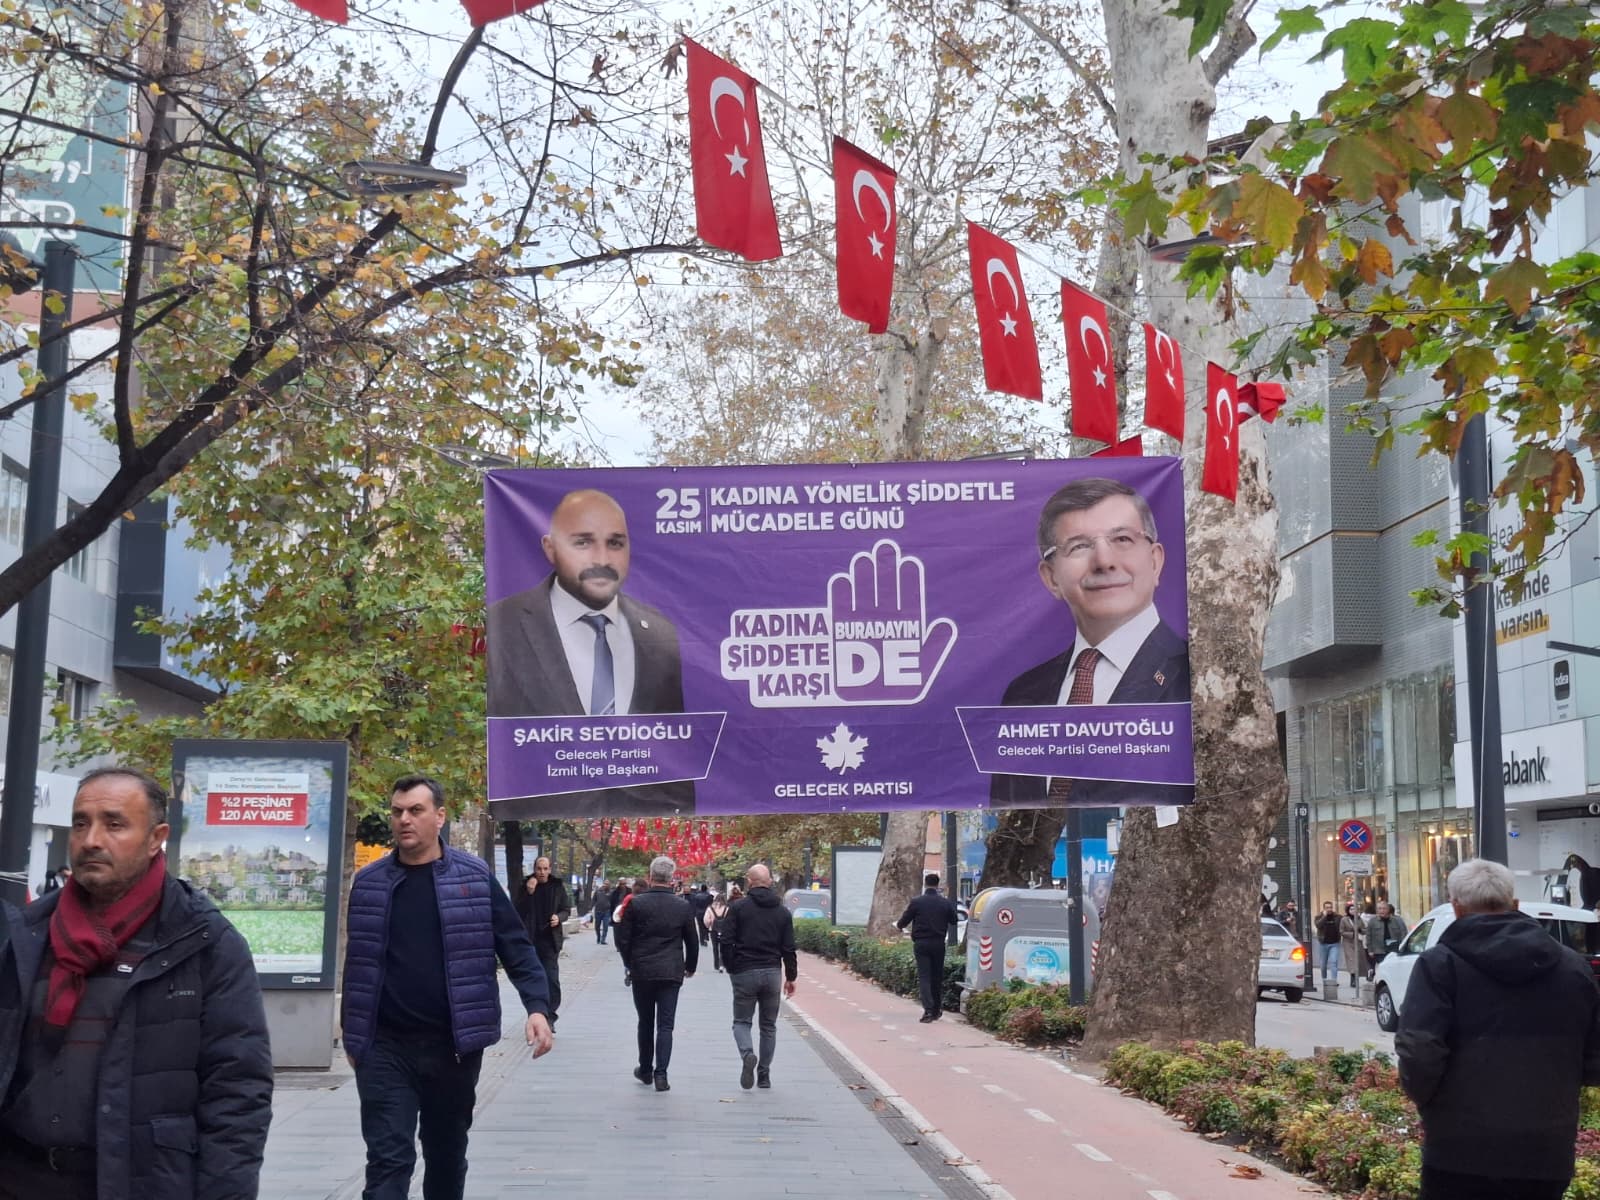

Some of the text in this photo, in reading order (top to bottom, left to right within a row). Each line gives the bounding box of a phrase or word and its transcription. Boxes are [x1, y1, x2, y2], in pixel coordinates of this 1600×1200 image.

[655, 488, 701, 519] 25
[710, 480, 1015, 507] KADINA YÖNELİK ŞİDDETLE
[655, 520, 702, 534] KASIM
[711, 506, 905, 533] MÜCADELE GÜNÜ
[1496, 569, 1550, 611] kende
[734, 612, 830, 638] KADINA
[834, 620, 920, 640] BURADAYIM
[727, 643, 830, 672] ŞİDDETE
[835, 639, 922, 688] DE
[757, 672, 831, 700] KARŞI
[513, 722, 692, 747] ŞAKİR SEYDİOĞLU
[998, 718, 1174, 739] AHMET DAVUTOĞLU
[555, 748, 651, 761] Gelecek Partisi
[998, 742, 1170, 756] Gelecek Partisi Genel Başkanı
[547, 763, 658, 778] İzmit İlçe Başkanı
[1503, 746, 1546, 785] abank
[221, 795, 294, 809] %2 PEŞİNAT
[774, 782, 849, 798] GELECEK
[219, 811, 294, 821] 120 AY VADE
